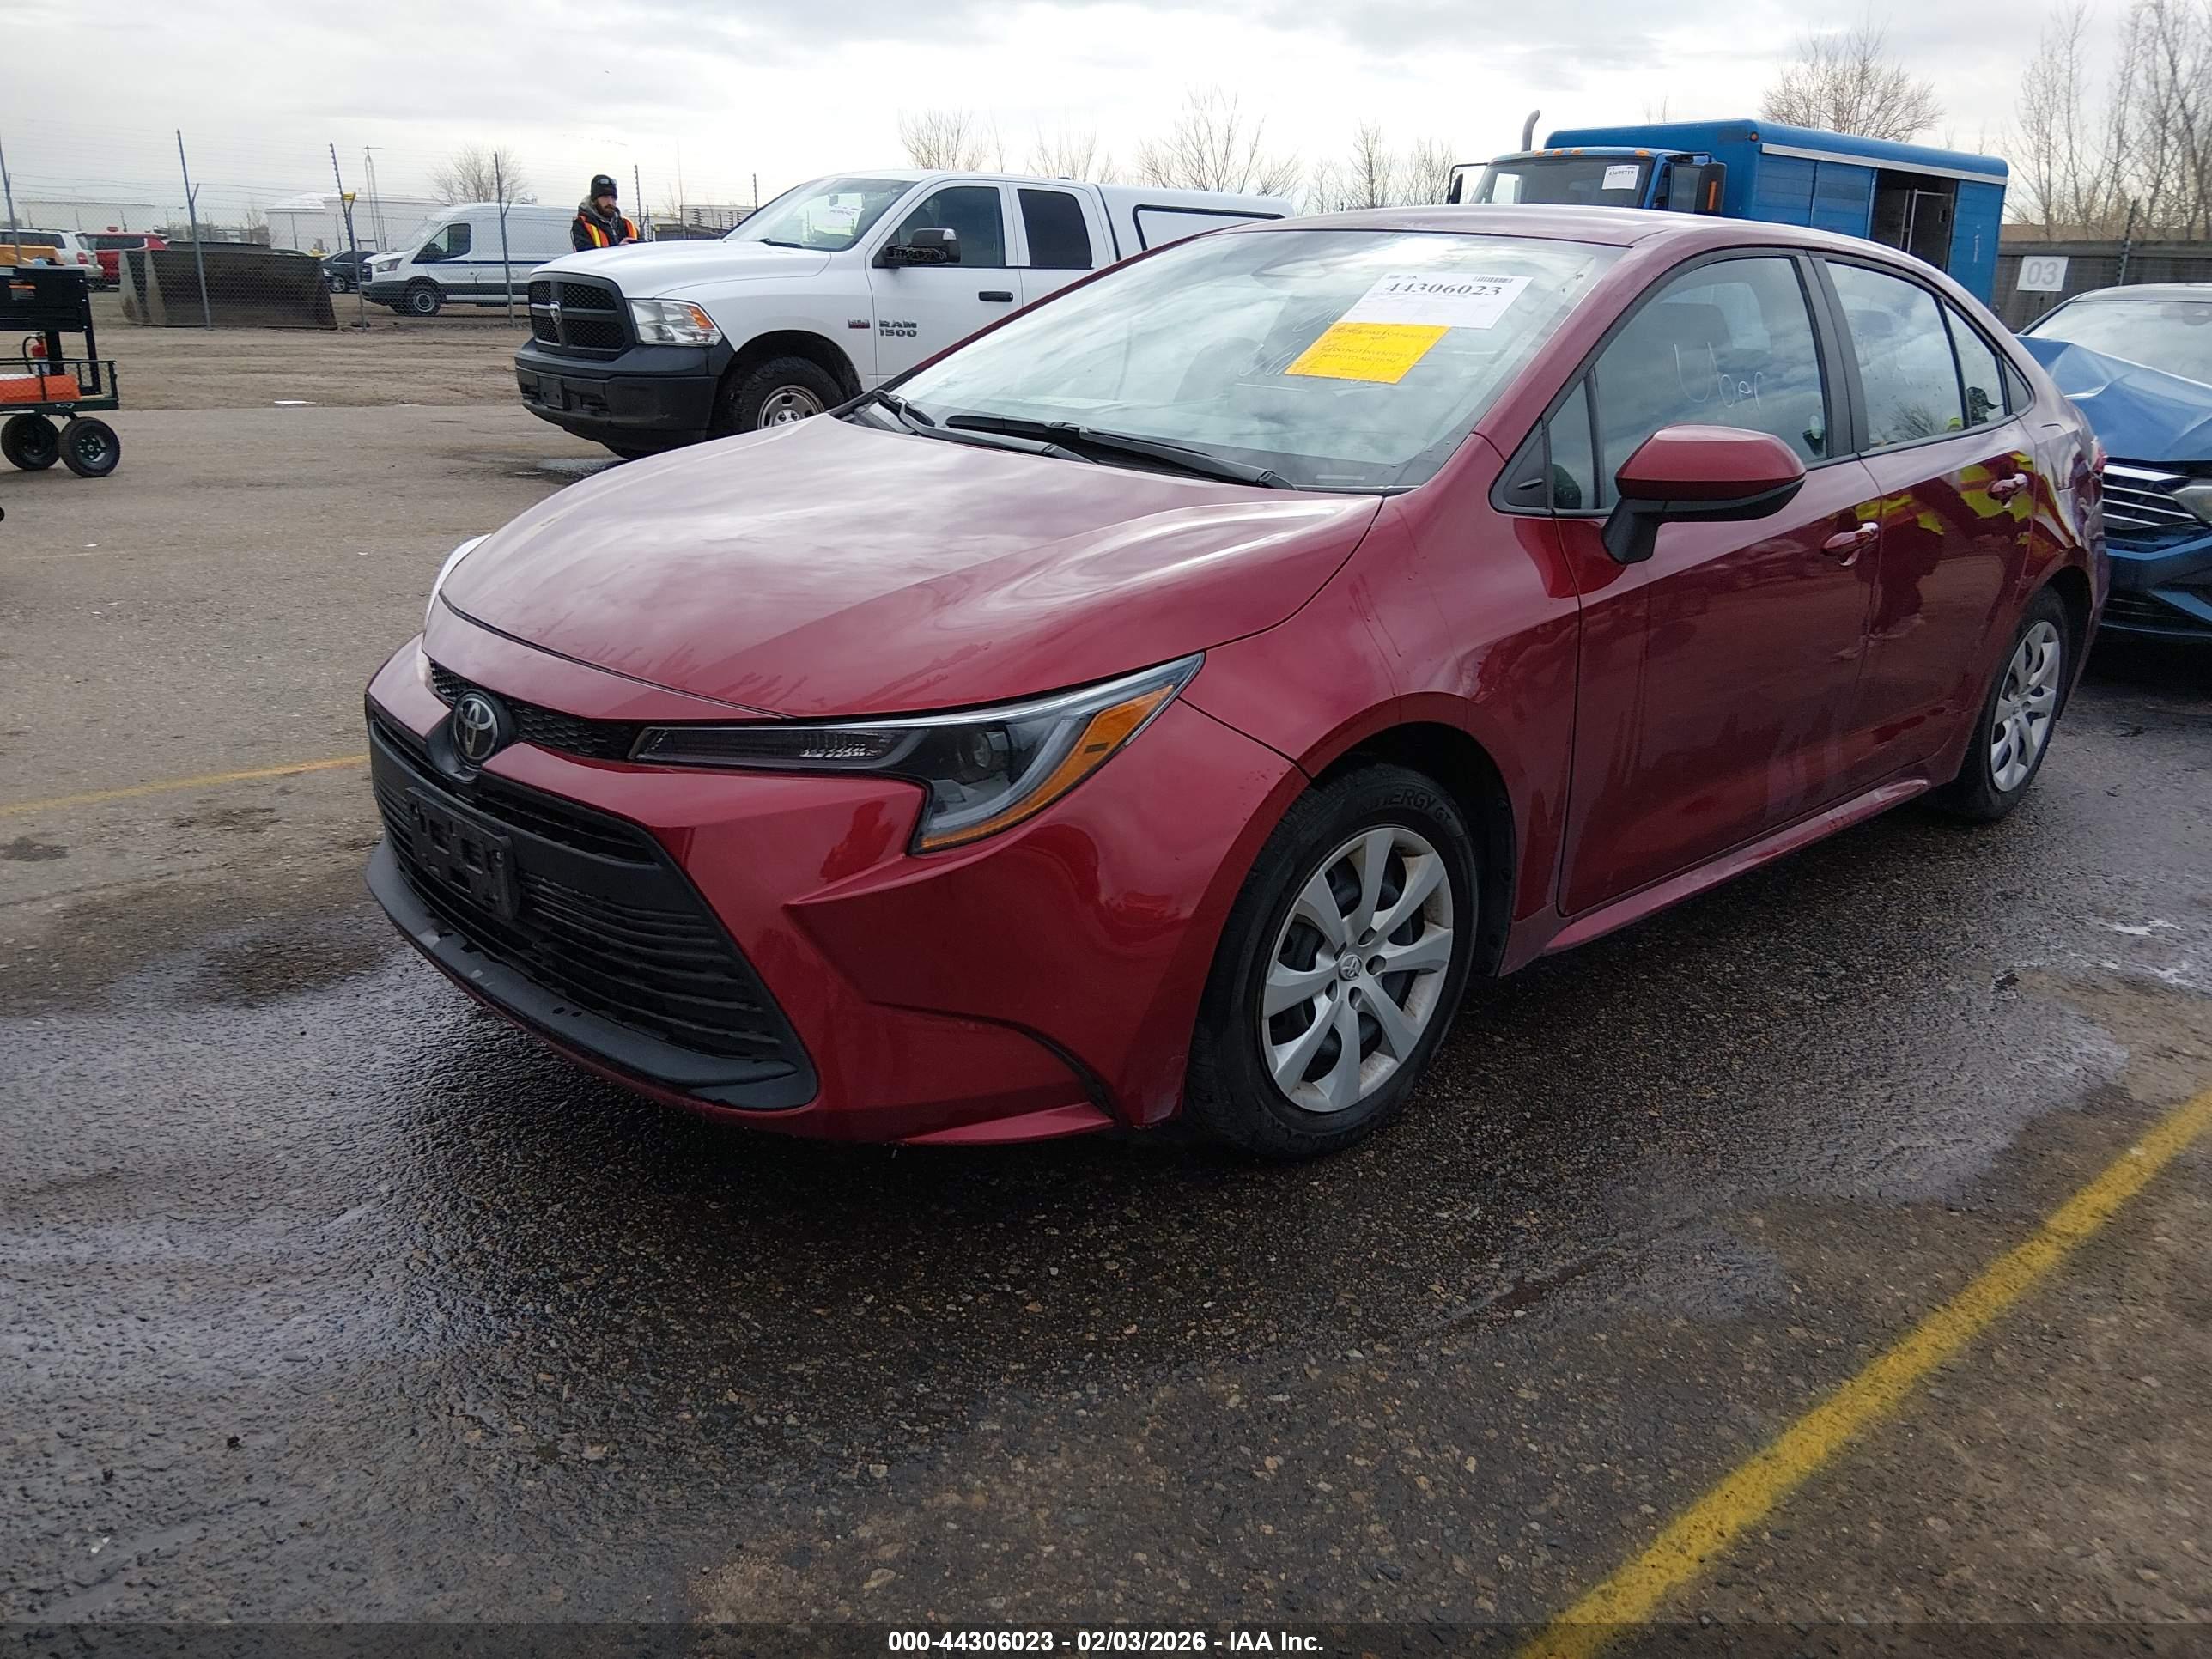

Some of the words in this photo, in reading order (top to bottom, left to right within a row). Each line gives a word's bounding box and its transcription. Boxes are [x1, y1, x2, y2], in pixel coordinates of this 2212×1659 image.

[2027, 261, 2058, 285] 03
[1384, 283, 1503, 296] 44306023
[878, 319, 917, 328] RAM
[878, 328, 917, 337] 1500
[1673, 342, 1765, 410] Uber
